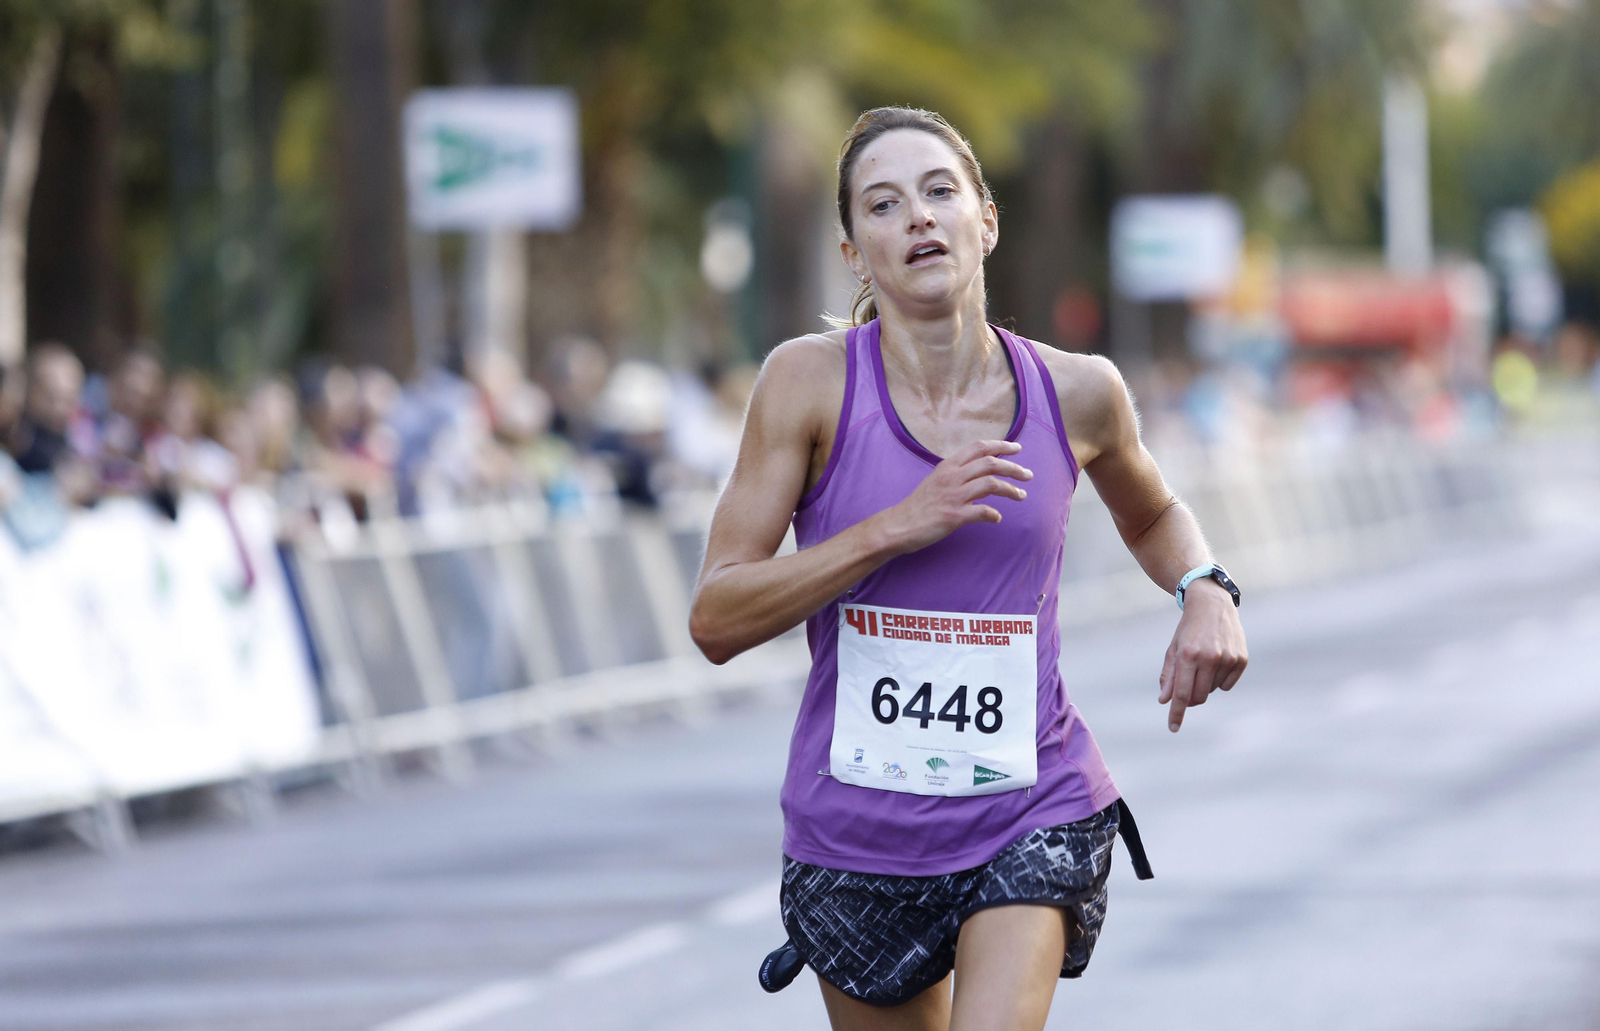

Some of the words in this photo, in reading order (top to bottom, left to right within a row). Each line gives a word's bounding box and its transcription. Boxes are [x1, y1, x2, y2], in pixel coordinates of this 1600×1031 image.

[845, 608, 879, 637] 41
[881, 612, 965, 633] CARRERA
[969, 619, 1033, 635] URBANA
[882, 627, 931, 642] CIUDAD
[935, 632, 952, 644] DE
[956, 633, 1011, 646] MÁLAGA
[871, 676, 1004, 735] 6448
[882, 762, 908, 779] 2020
